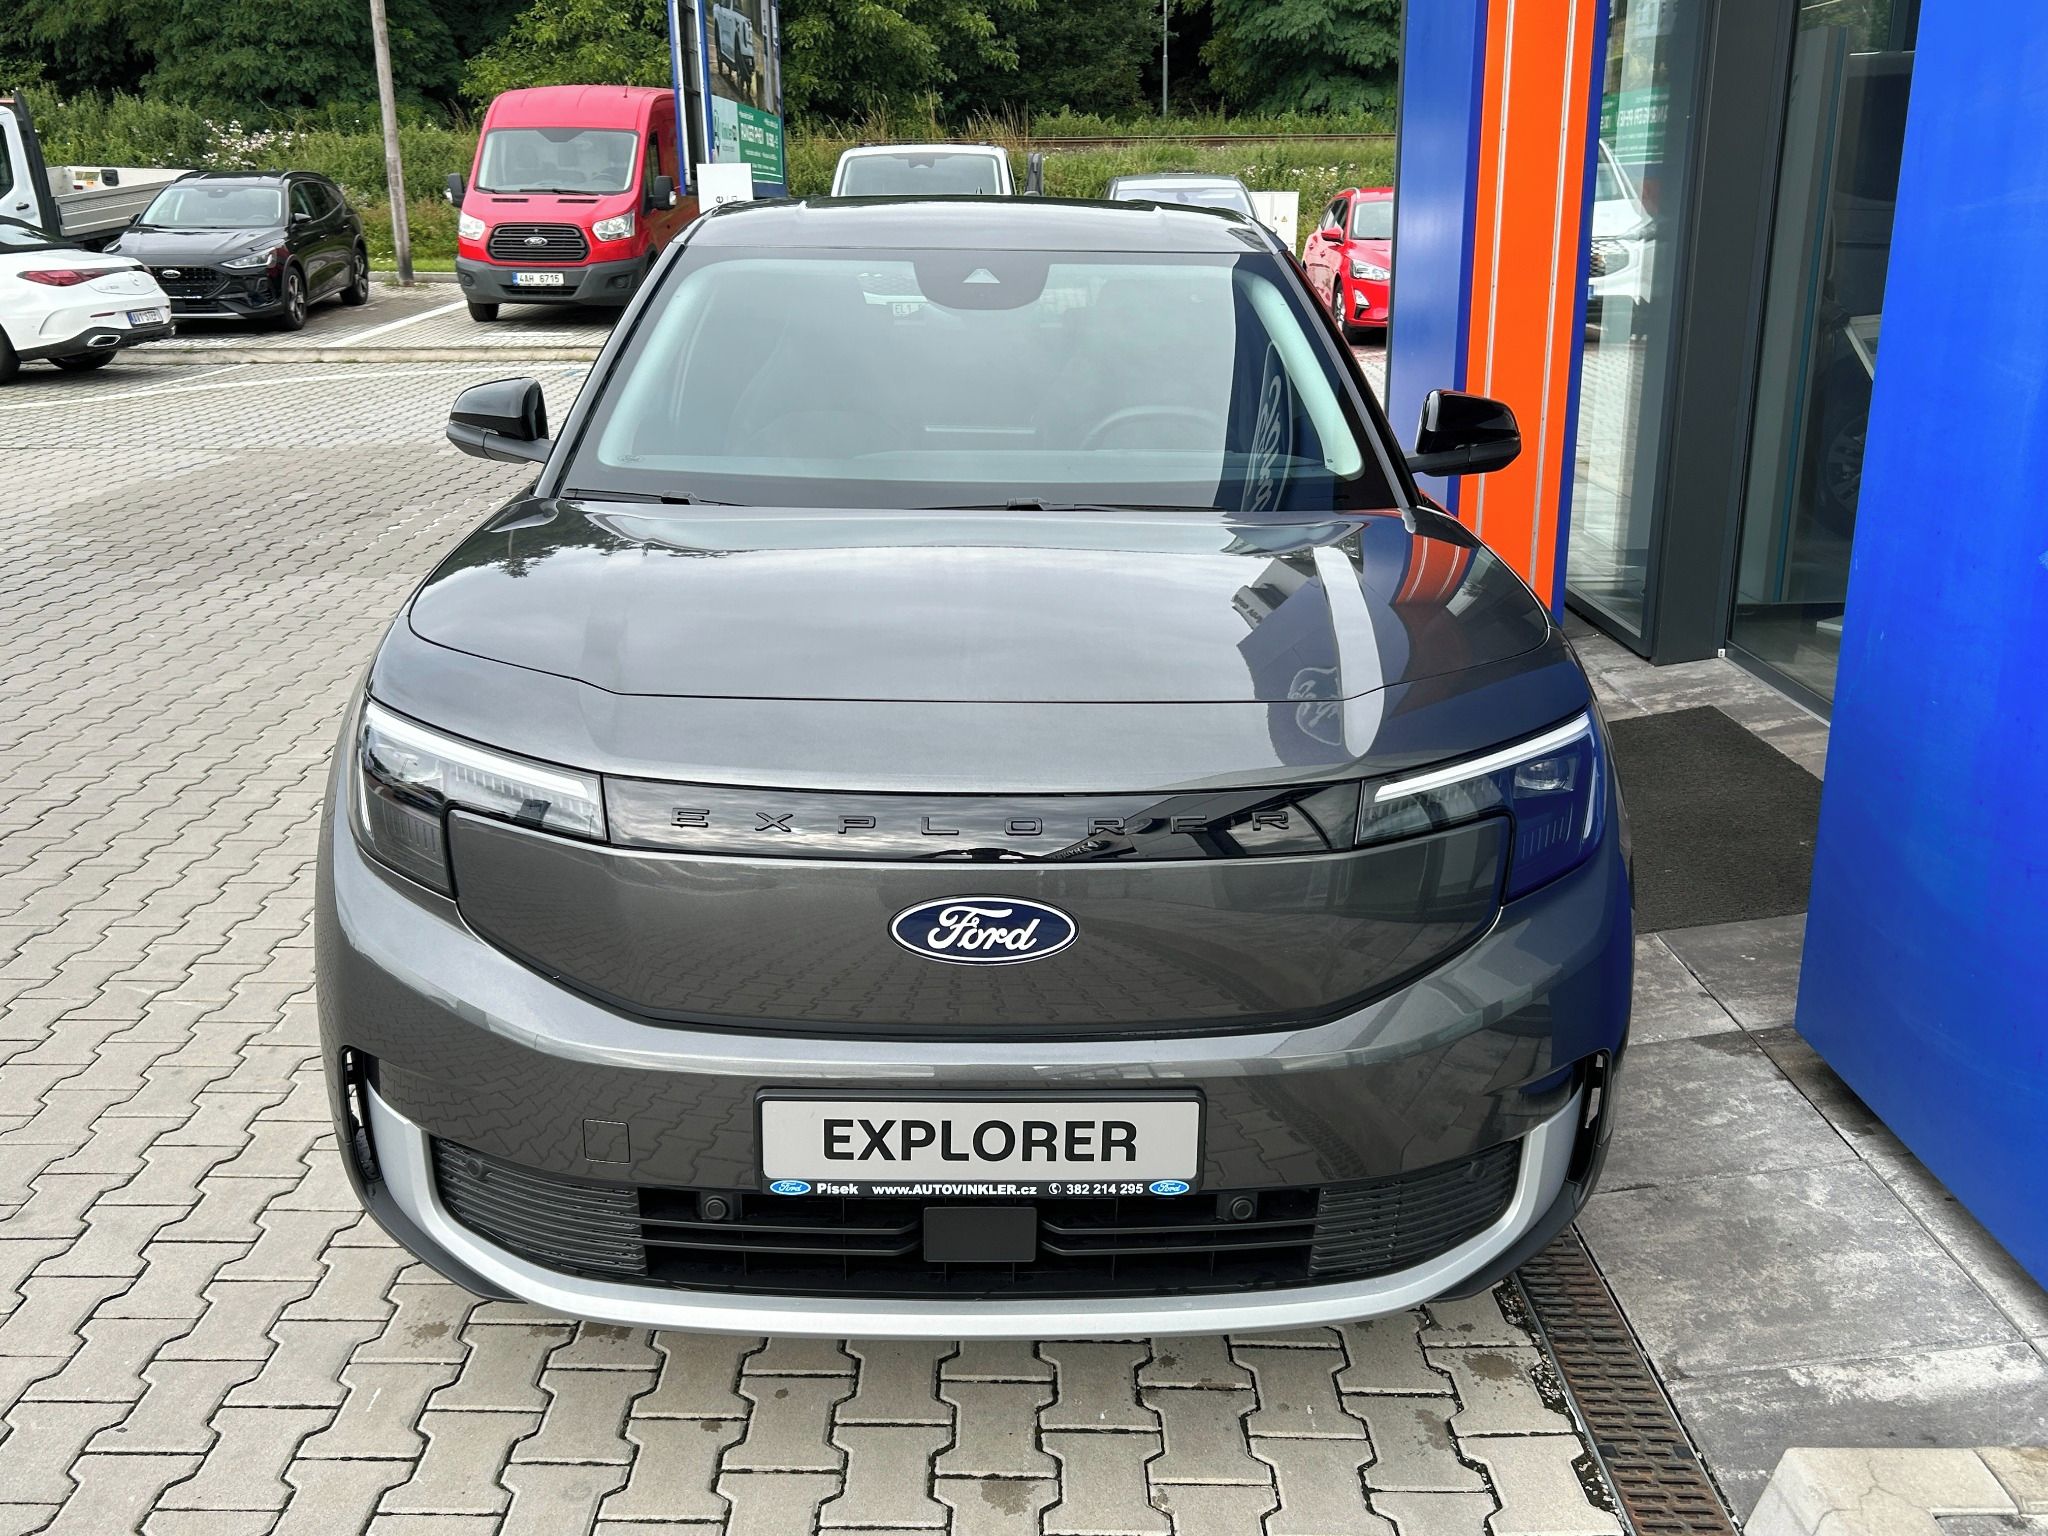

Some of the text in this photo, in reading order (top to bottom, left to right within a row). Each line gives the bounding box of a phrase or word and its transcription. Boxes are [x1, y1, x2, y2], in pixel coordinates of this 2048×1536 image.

[519, 274, 534, 283] 4AH
[671, 807, 1289, 837] EXPLORER
[927, 905, 1041, 951] Ford
[822, 1118, 1138, 1162] EXPLORER
[816, 1182, 859, 1195] Písek
[871, 1184, 1037, 1196] www.AUTOVINKLER.cz
[1066, 1184, 1090, 1195] 382
[1093, 1184, 1117, 1195] 214
[1119, 1184, 1144, 1195] 295
